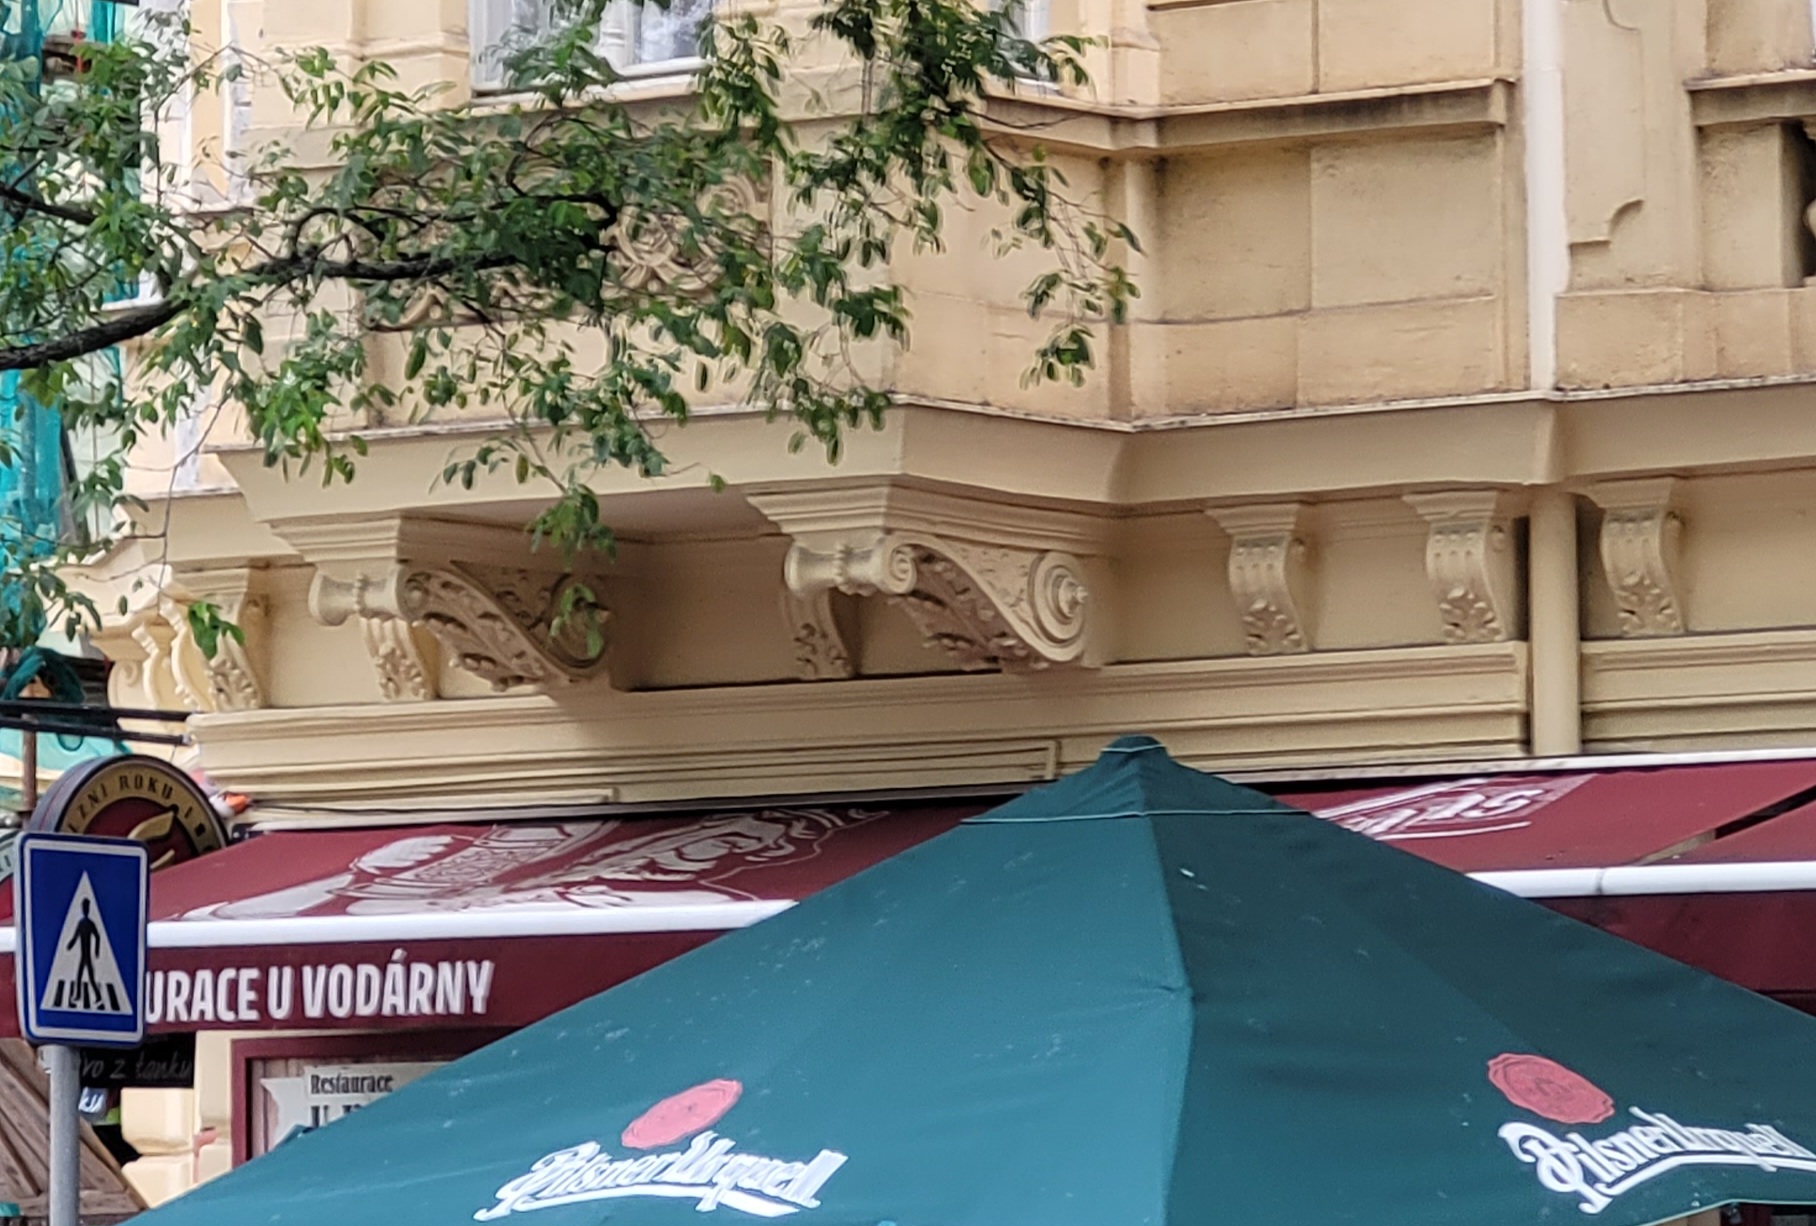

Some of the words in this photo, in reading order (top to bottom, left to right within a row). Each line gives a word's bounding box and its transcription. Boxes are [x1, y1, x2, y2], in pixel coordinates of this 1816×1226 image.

[67, 783, 108, 833] LZNI
[119, 774, 173, 800] ROKU
[145, 967, 261, 1024] URACE
[267, 965, 293, 1020] U
[302, 948, 495, 1019] VODÁRNY
[310, 1073, 394, 1094] Restaurace
[473, 1140, 681, 1223] Pilsner
[1498, 1121, 1680, 1215] Pilsner
